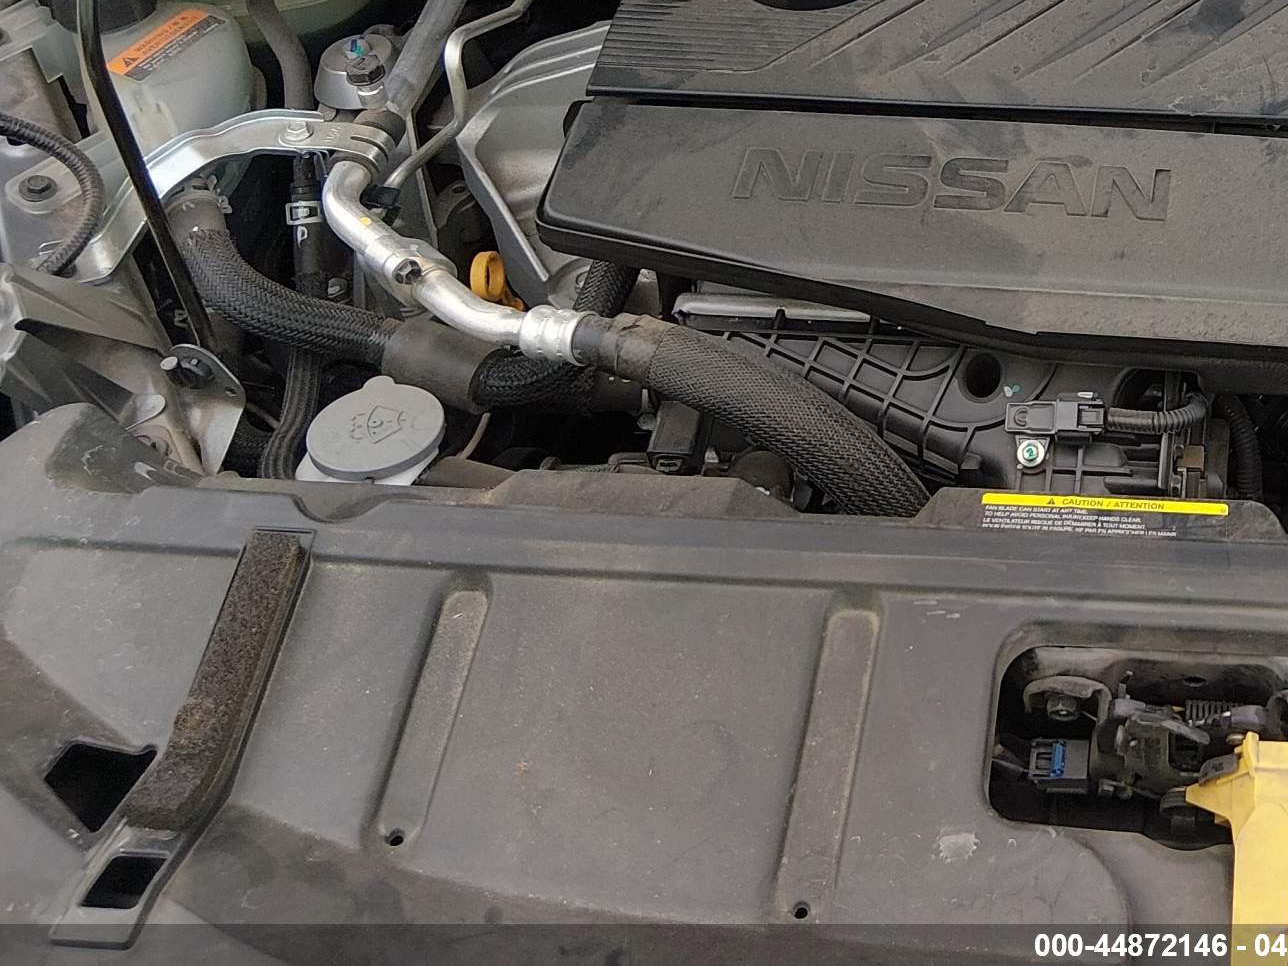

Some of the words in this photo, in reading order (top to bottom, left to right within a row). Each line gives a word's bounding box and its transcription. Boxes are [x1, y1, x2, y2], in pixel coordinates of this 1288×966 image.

[731, 145, 1172, 222] NISSAN
[1062, 497, 1104, 507] CAUTION
[1113, 500, 1165, 510] ATTENTION
